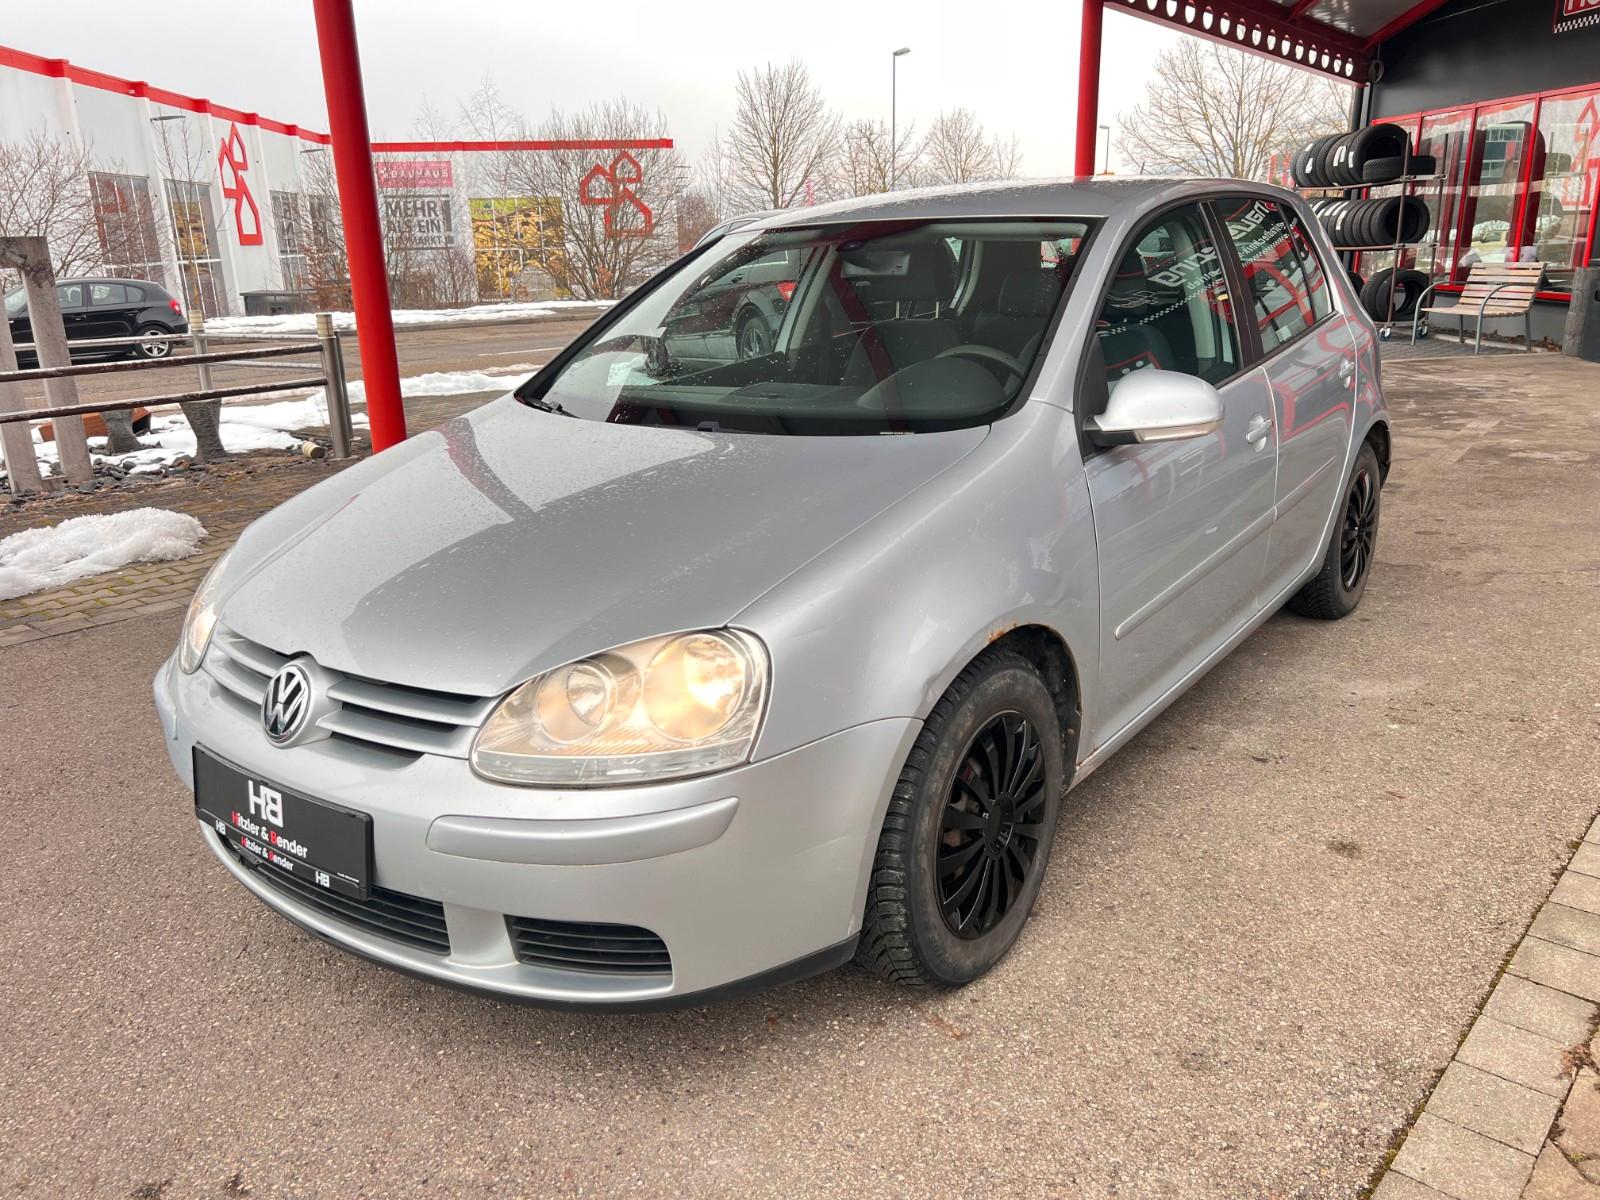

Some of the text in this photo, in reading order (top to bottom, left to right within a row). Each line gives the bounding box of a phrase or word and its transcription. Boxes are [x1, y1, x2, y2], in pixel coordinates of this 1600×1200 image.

[385, 199, 439, 218] MEHR
[387, 219, 442, 234] ALS EIN
[248, 780, 284, 828] HB
[231, 810, 308, 858] Hitzler & Bender
[241, 836, 294, 871] Hitzler & Bender
[315, 870, 330, 888] HB
